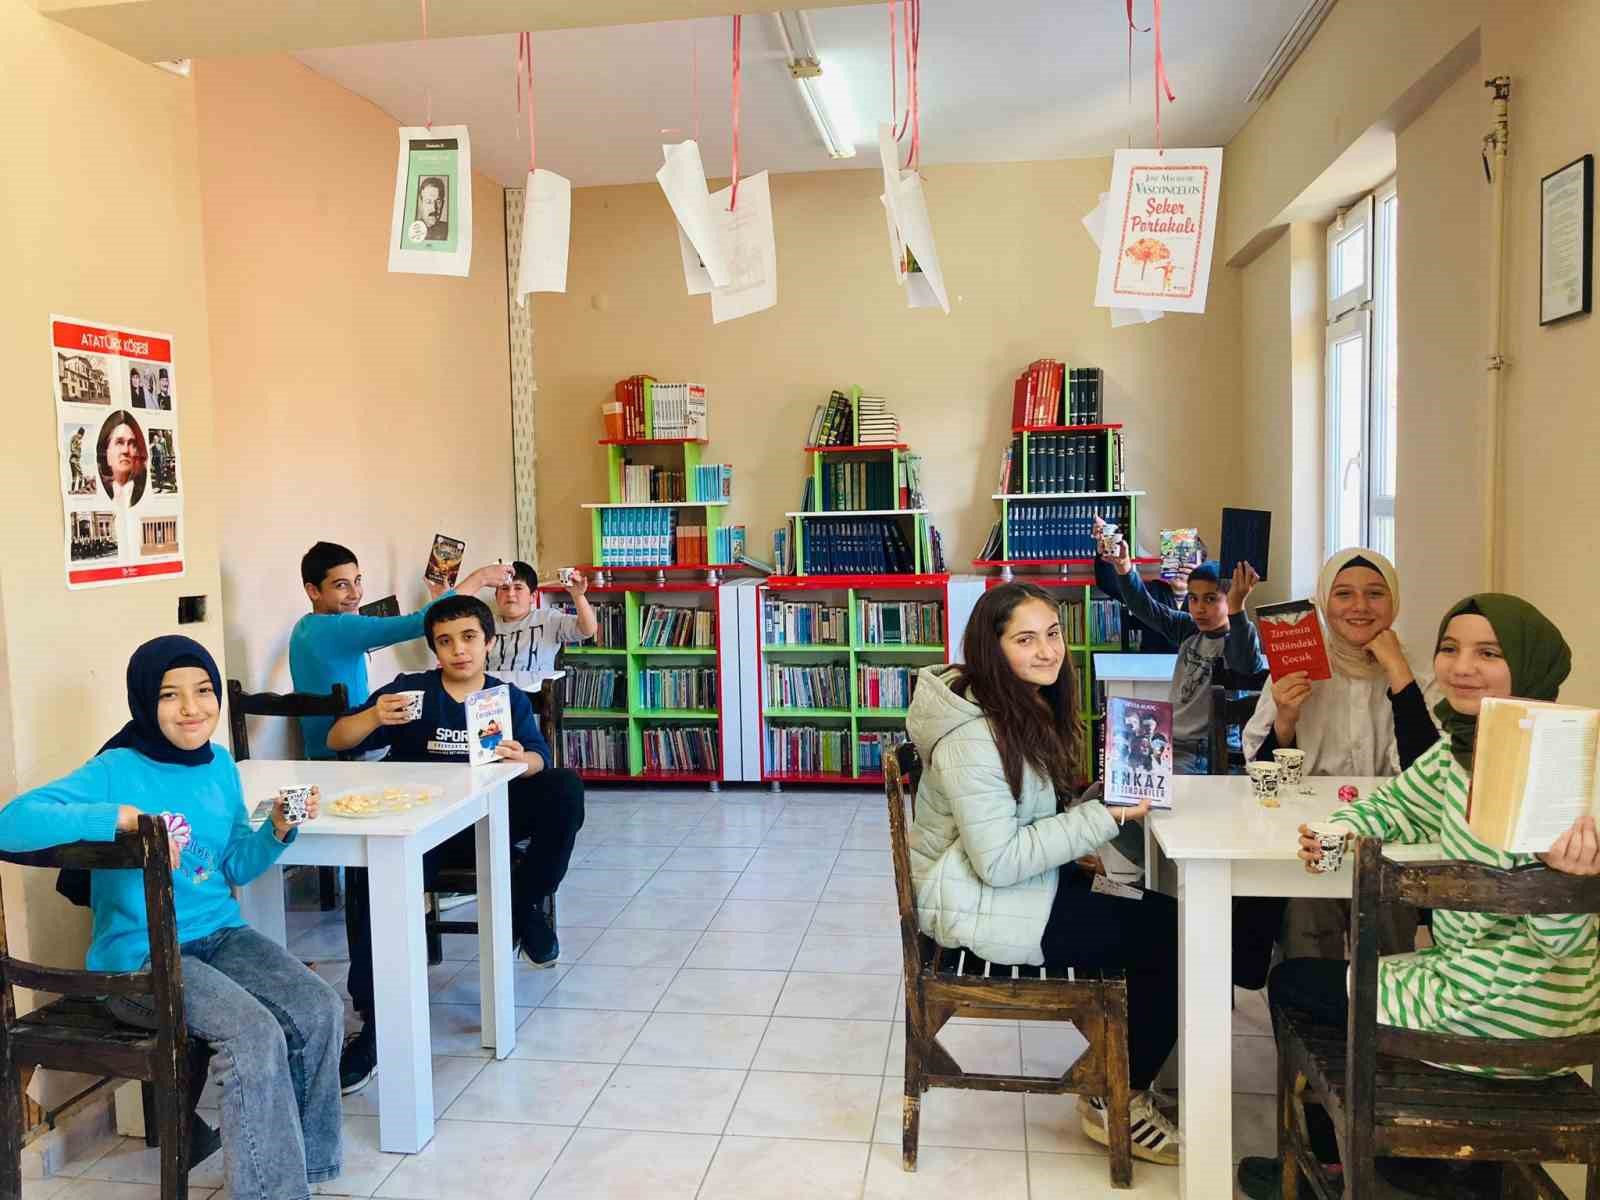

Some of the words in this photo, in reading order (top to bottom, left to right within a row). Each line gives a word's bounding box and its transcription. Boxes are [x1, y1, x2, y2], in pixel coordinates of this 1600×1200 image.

[1135, 182, 1201, 195] VASCONCELOS
[1146, 197, 1185, 217] Şeker
[1130, 215, 1196, 234] Portakalı
[80, 333, 122, 352] ATATÜRK
[1270, 626, 1311, 639] Zirvenin
[1271, 639, 1318, 652] Dibindeki
[1281, 652, 1312, 665] Çocuk
[1111, 770, 1164, 790] ENKAZ
